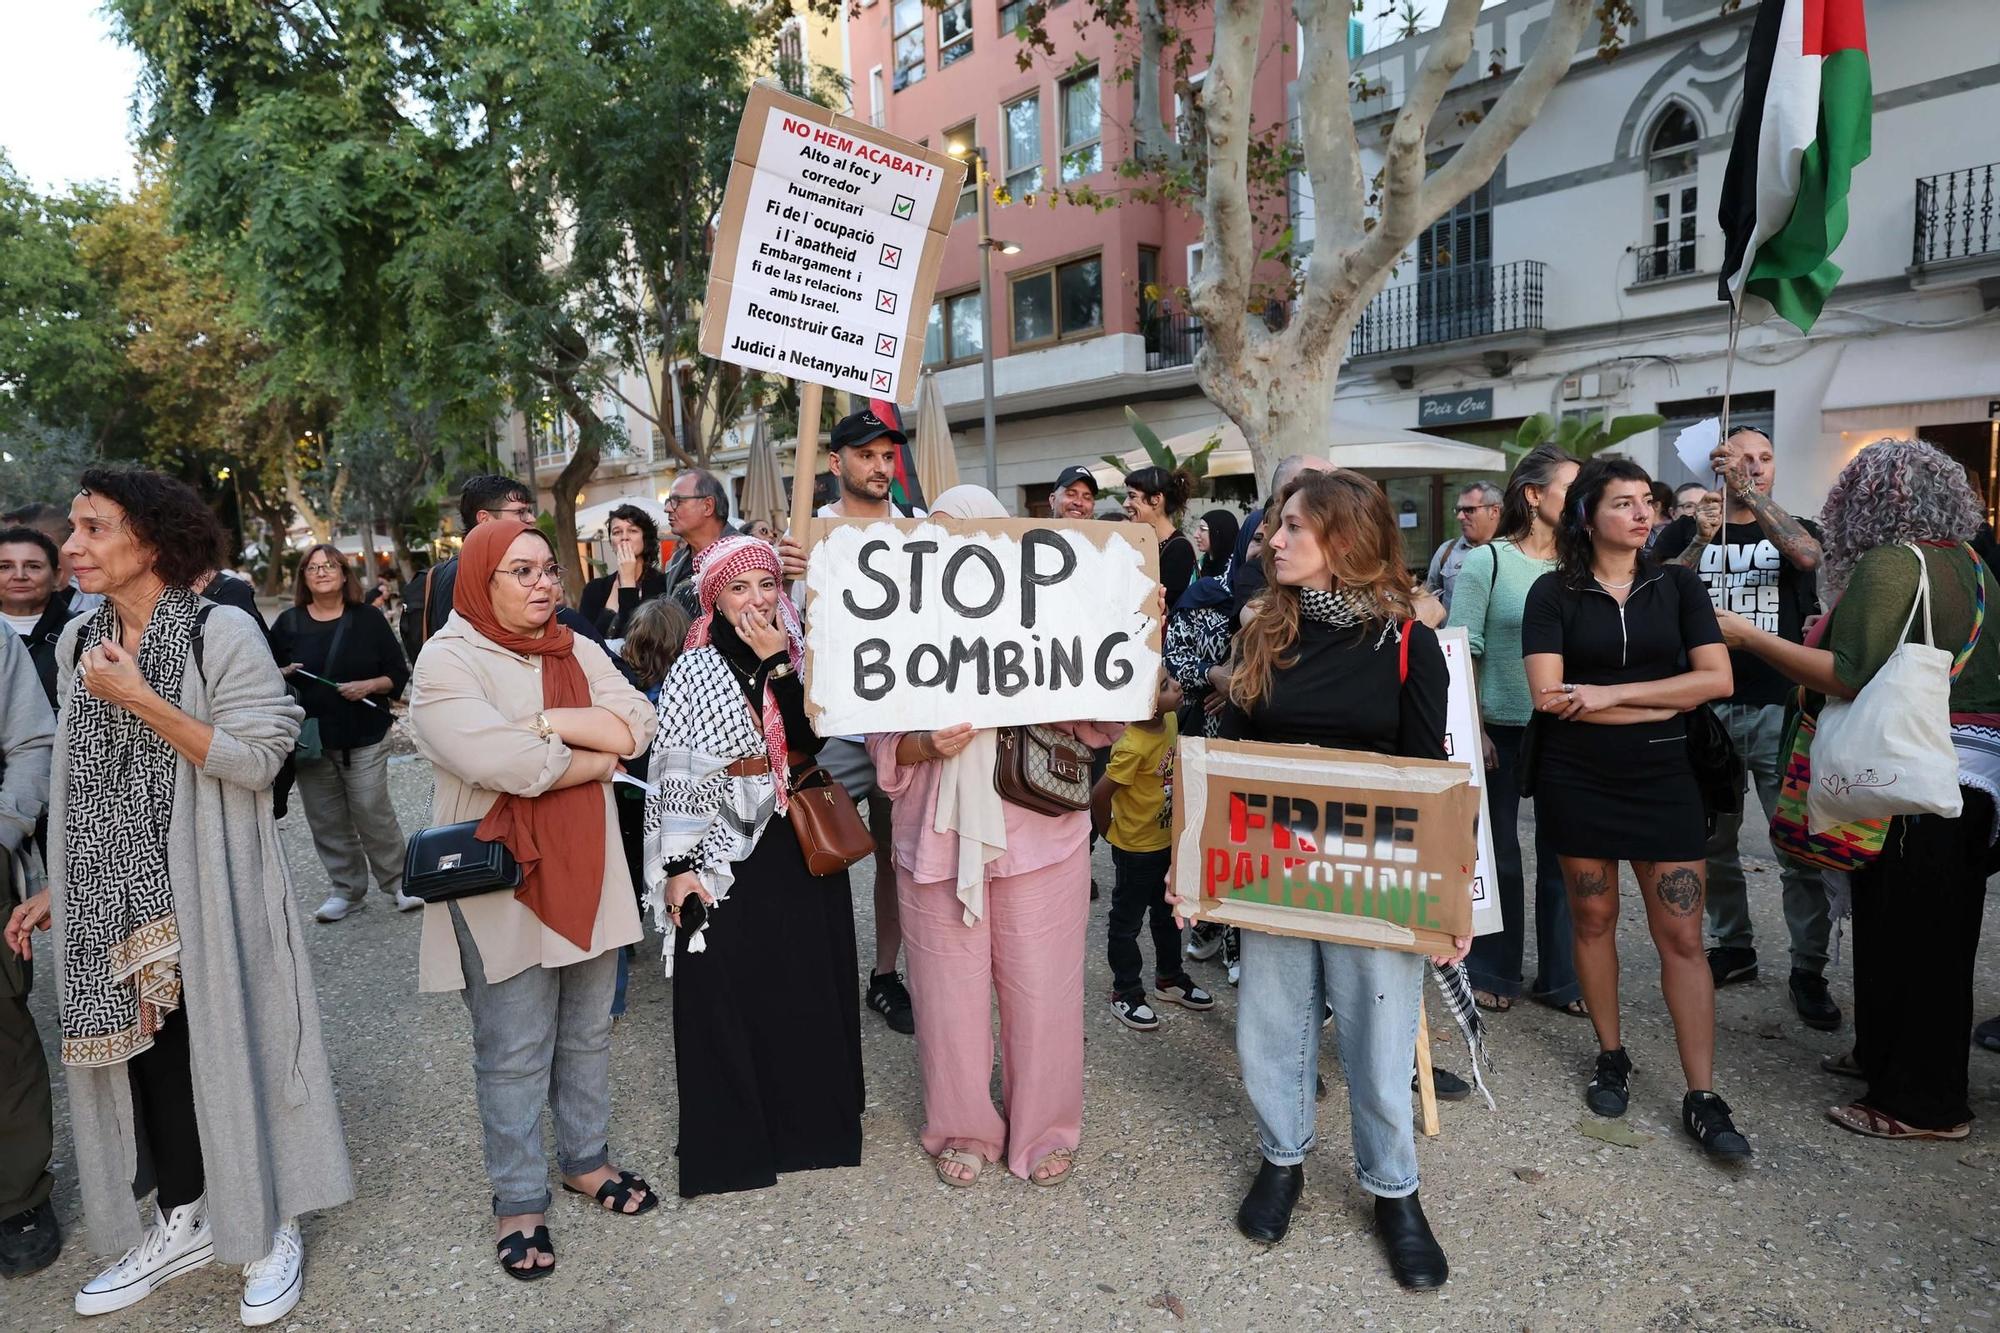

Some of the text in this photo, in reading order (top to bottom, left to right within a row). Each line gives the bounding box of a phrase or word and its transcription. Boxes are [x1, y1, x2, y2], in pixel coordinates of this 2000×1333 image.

[783, 118, 810, 137] NO
[814, 129, 853, 153] HEM
[855, 145, 924, 177] ACABAT
[800, 146, 881, 184] Alto al foc y
[788, 183, 864, 216] humanitari
[802, 169, 860, 195] corredor
[766, 200, 780, 215] Fi
[783, 206, 800, 221] de
[776, 226, 782, 239] i
[752, 260, 863, 301] fi de las relacions
[759, 243, 862, 282] Embargament i
[769, 287, 839, 313] amb Israel.
[748, 303, 864, 346] Reconstruir Gaza
[731, 336, 868, 382] Judici a Netanyahu
[1423, 397, 1487, 417] Peix Cru
[1699, 539, 1780, 573] ove
[843, 528, 1077, 629] STOP
[1707, 586, 1779, 613] ate
[1229, 792, 1419, 864] FREE
[1206, 847, 1442, 929] PALESTINE
